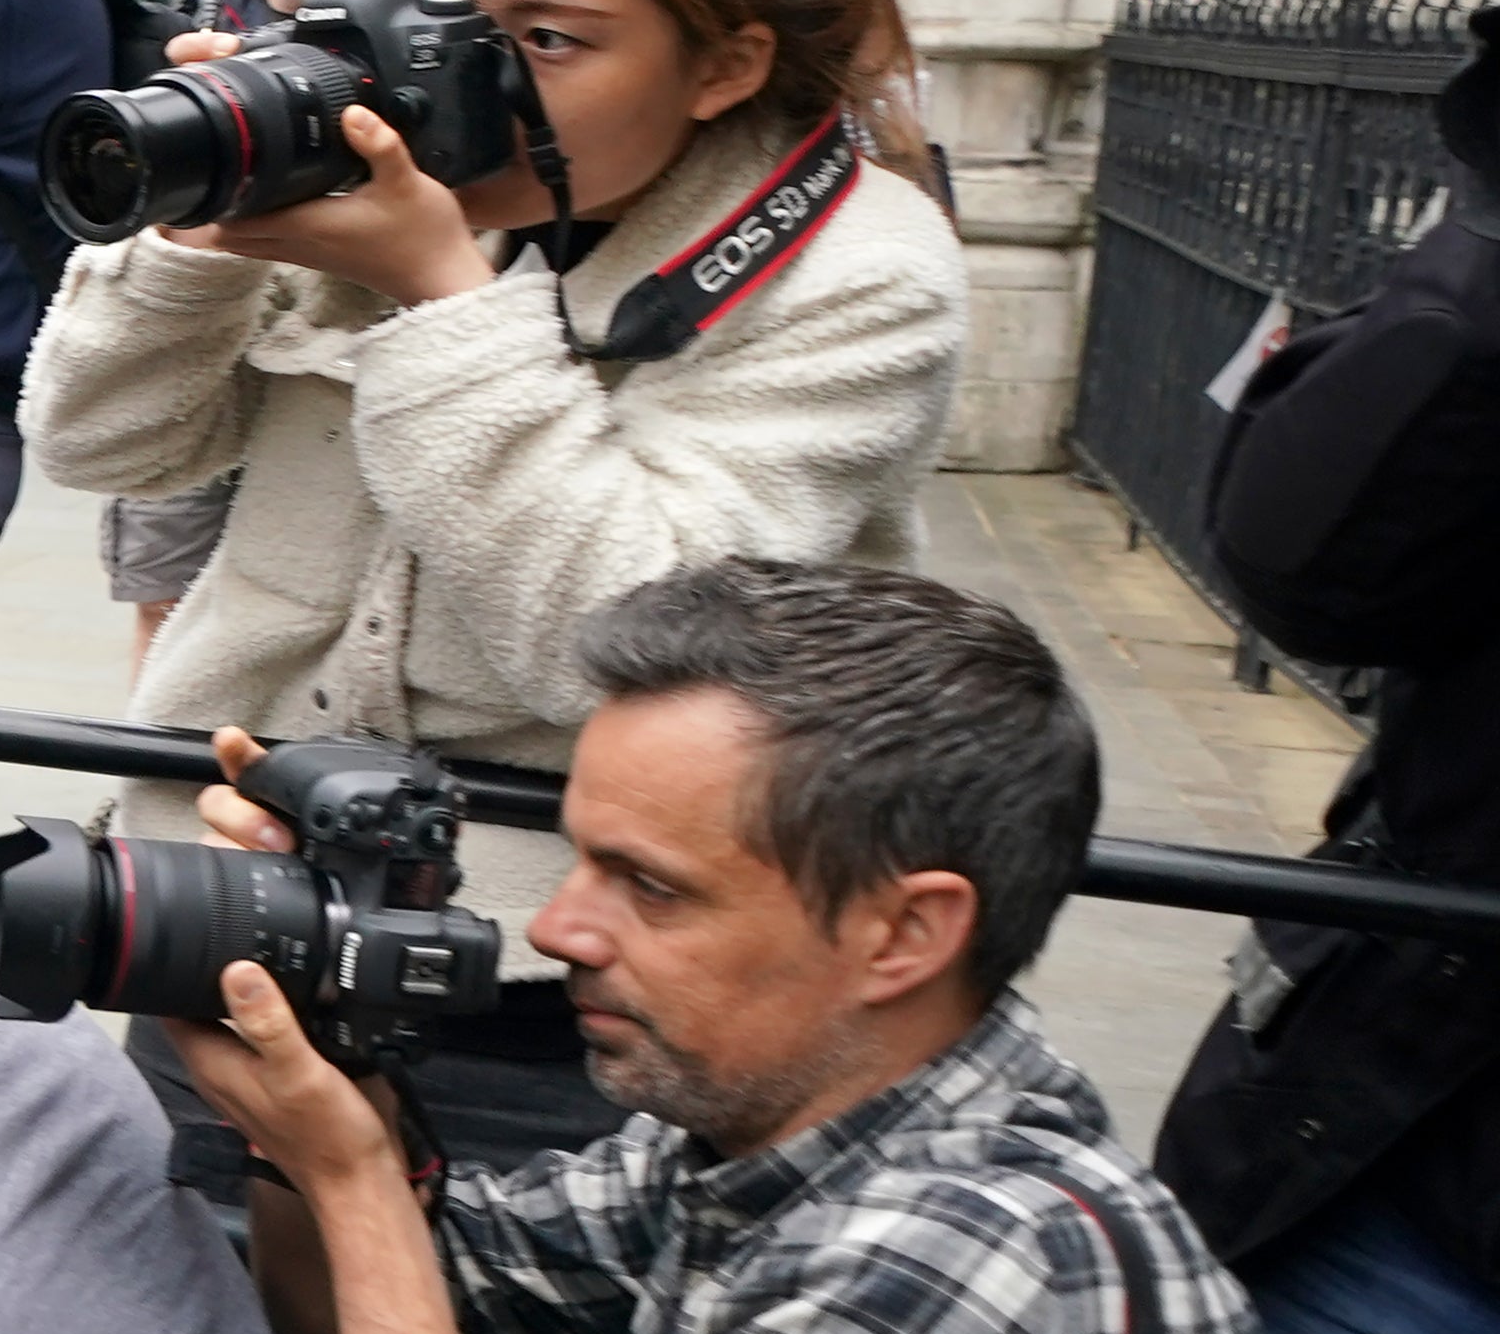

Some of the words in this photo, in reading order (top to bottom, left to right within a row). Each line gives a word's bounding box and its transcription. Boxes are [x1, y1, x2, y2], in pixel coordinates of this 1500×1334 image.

[294, 6, 348, 23] Canon
[409, 32, 442, 47] EOS
[691, 214, 775, 293] EOS
[764, 185, 810, 231] 5D
